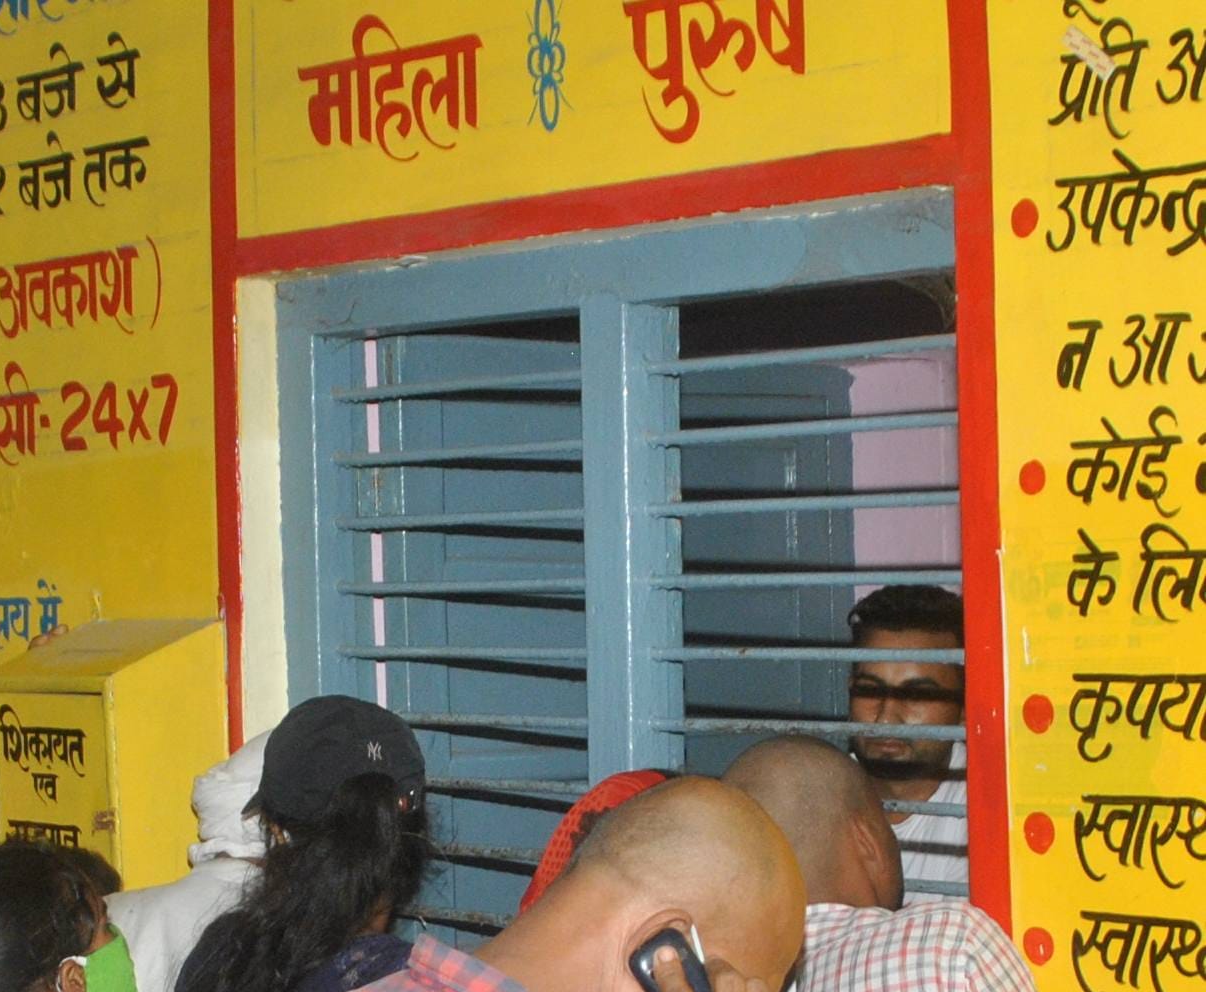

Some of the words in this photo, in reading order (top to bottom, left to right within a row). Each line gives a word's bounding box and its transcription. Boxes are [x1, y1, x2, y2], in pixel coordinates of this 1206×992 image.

[17, 42, 84, 122] बजे
[96, 31, 140, 108] से
[298, 14, 484, 161] महिला
[18, 131, 75, 210] बजे
[83, 136, 150, 207] तक
[1066, 405, 1182, 518] कोई
[1066, 528, 1119, 617] के
[1132, 522, 1206, 623] लि
